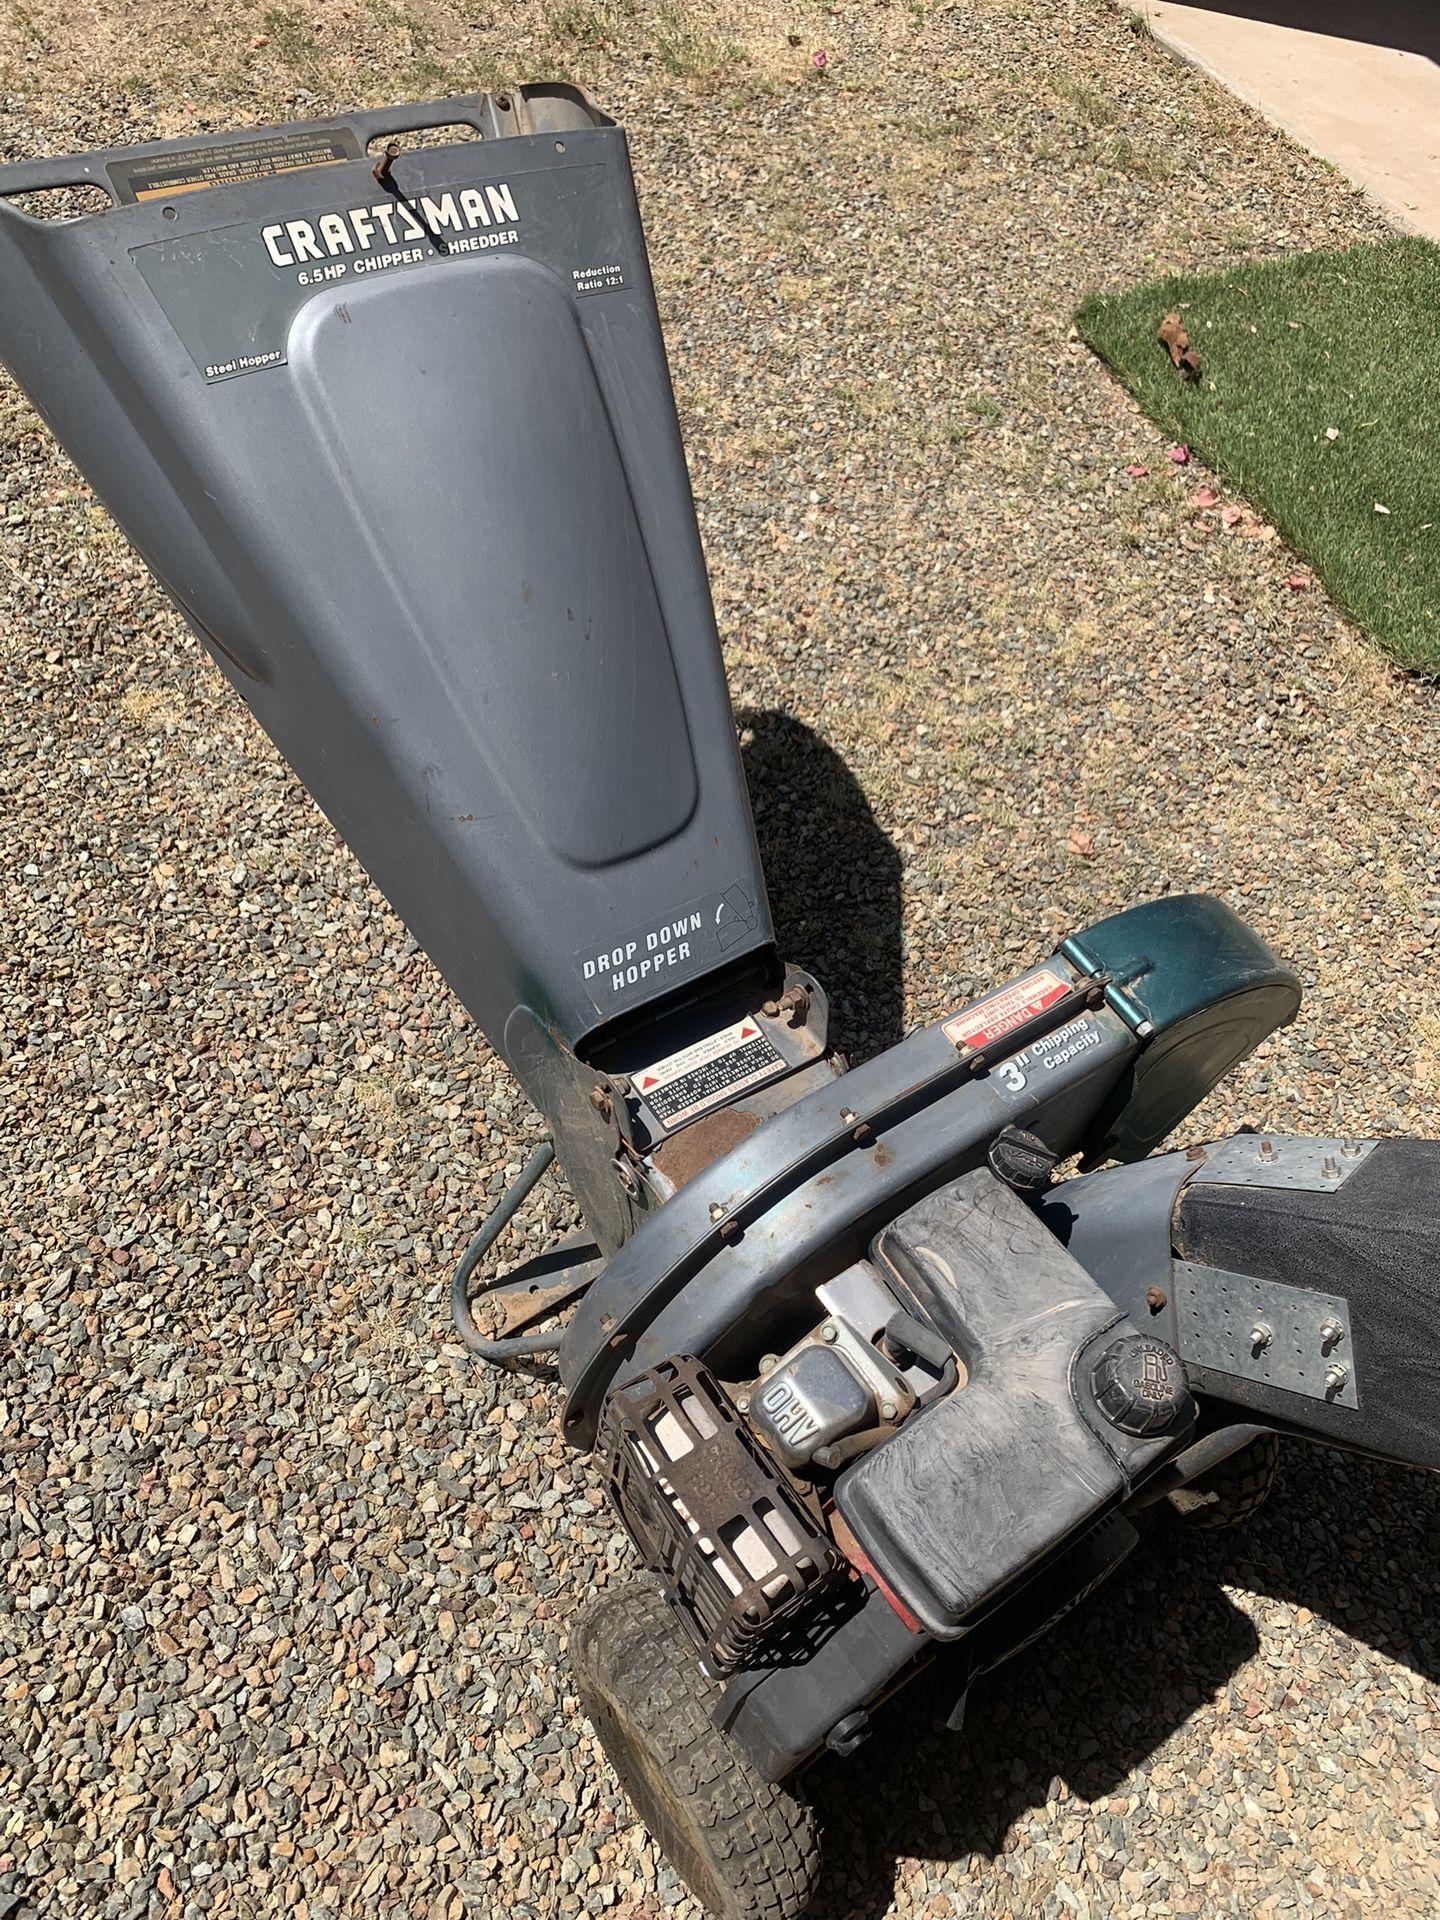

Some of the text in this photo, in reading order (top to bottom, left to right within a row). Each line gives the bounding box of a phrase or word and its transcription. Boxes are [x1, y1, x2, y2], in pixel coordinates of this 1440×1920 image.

[147, 177, 185, 188] COMBUSTIBLE
[185, 174, 203, 182] OTHER
[204, 172, 216, 180] AND
[261, 183, 520, 268] CRAFTSMAN
[298, 230, 519, 286] 6.5HP CHIPPER SHREDDER
[572, 265, 621, 279] Reduction
[577, 275, 623, 291] Ratio 12:1
[205, 351, 281, 377] Steel Hopper
[583, 912, 702, 980] DROP DOWN
[612, 942, 691, 991] HOPPER
[1020, 984, 1053, 1004] ASSEMBLE
[982, 993, 1024, 1018] TO THIS UNIT
[998, 1002, 1021, 1016] CHUTE
[982, 1006, 1033, 1040] DANGER
[1031, 1019, 1089, 1056] Chipping
[1043, 1031, 1101, 1069] Capacity
[724, 1057, 736, 1066] USE
[735, 1053, 755, 1066] CAUSE
[756, 1058, 769, 1067] NOT
[692, 1066, 719, 1082] CHIPPER
[719, 1062, 748, 1080] DIAMETER
[731, 1065, 756, 1080] DEPOSIT
[665, 1061, 784, 1125] SAFETY GLASSES SHOULD BE WORN
[667, 1082, 688, 1095] CHUTE
[701, 1078, 730, 1096] MATERIAL
[648, 1096, 662, 1105] FOR
[651, 1088, 687, 1110] SHREDDING
[654, 1104, 670, 1114] THIS
[658, 1107, 675, 1119] THAN
[1128, 1343, 1174, 1365] UNLEADED
[1132, 1380, 1174, 1396] GASOLINE
[1141, 1390, 1165, 1401] ONLY
[762, 1381, 820, 1446] OHV
